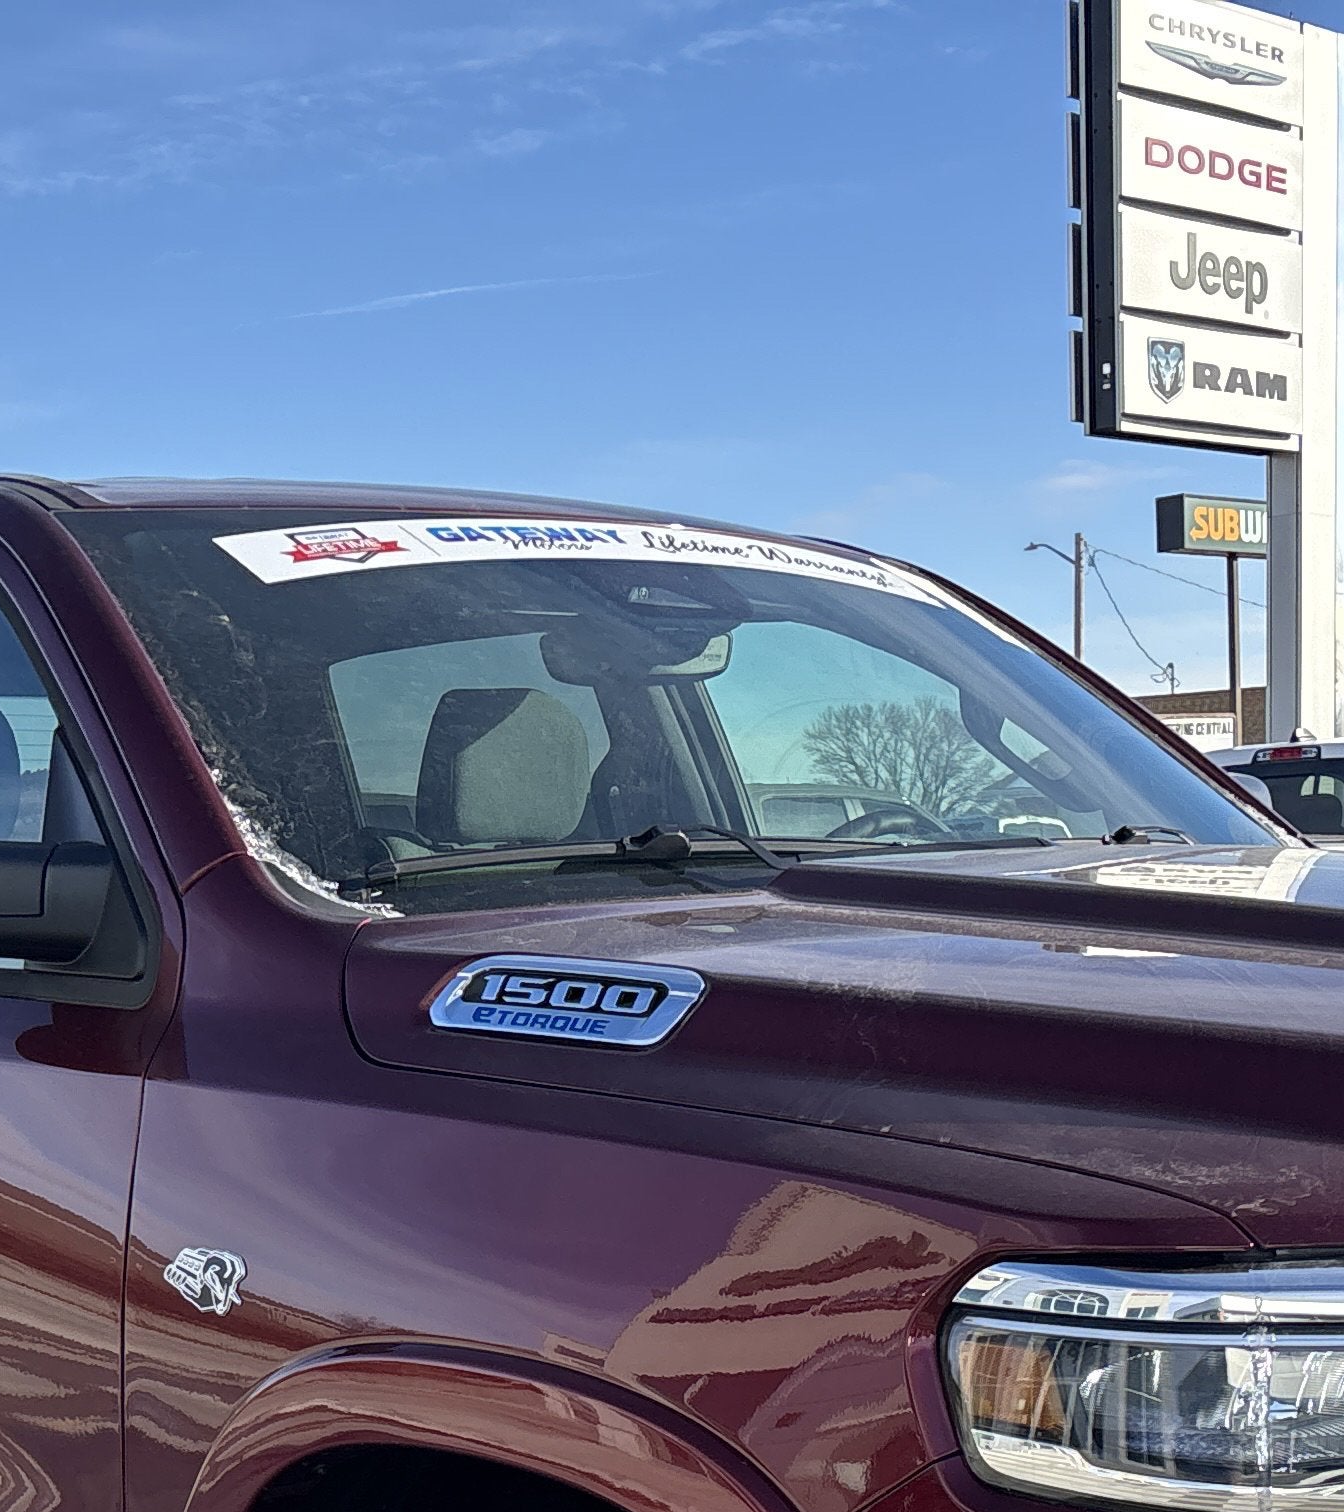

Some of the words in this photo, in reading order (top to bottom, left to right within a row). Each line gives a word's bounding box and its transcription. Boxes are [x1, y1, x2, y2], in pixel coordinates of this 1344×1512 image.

[1148, 13, 1285, 63] CHRYSLER
[1144, 136, 1288, 194] DODGE
[1170, 232, 1269, 314] Jeep
[1193, 361, 1288, 401] RAM
[426, 526, 627, 544] GATEWAY
[502, 537, 592, 550] Motors
[1190, 506, 1268, 543] SUBW
[297, 538, 382, 554] LIFETIME
[640, 530, 750, 558] Lifetime
[748, 544, 892, 588] Warranty
[1196, 722, 1233, 735] CENTRAL
[481, 974, 657, 1013] 1500
